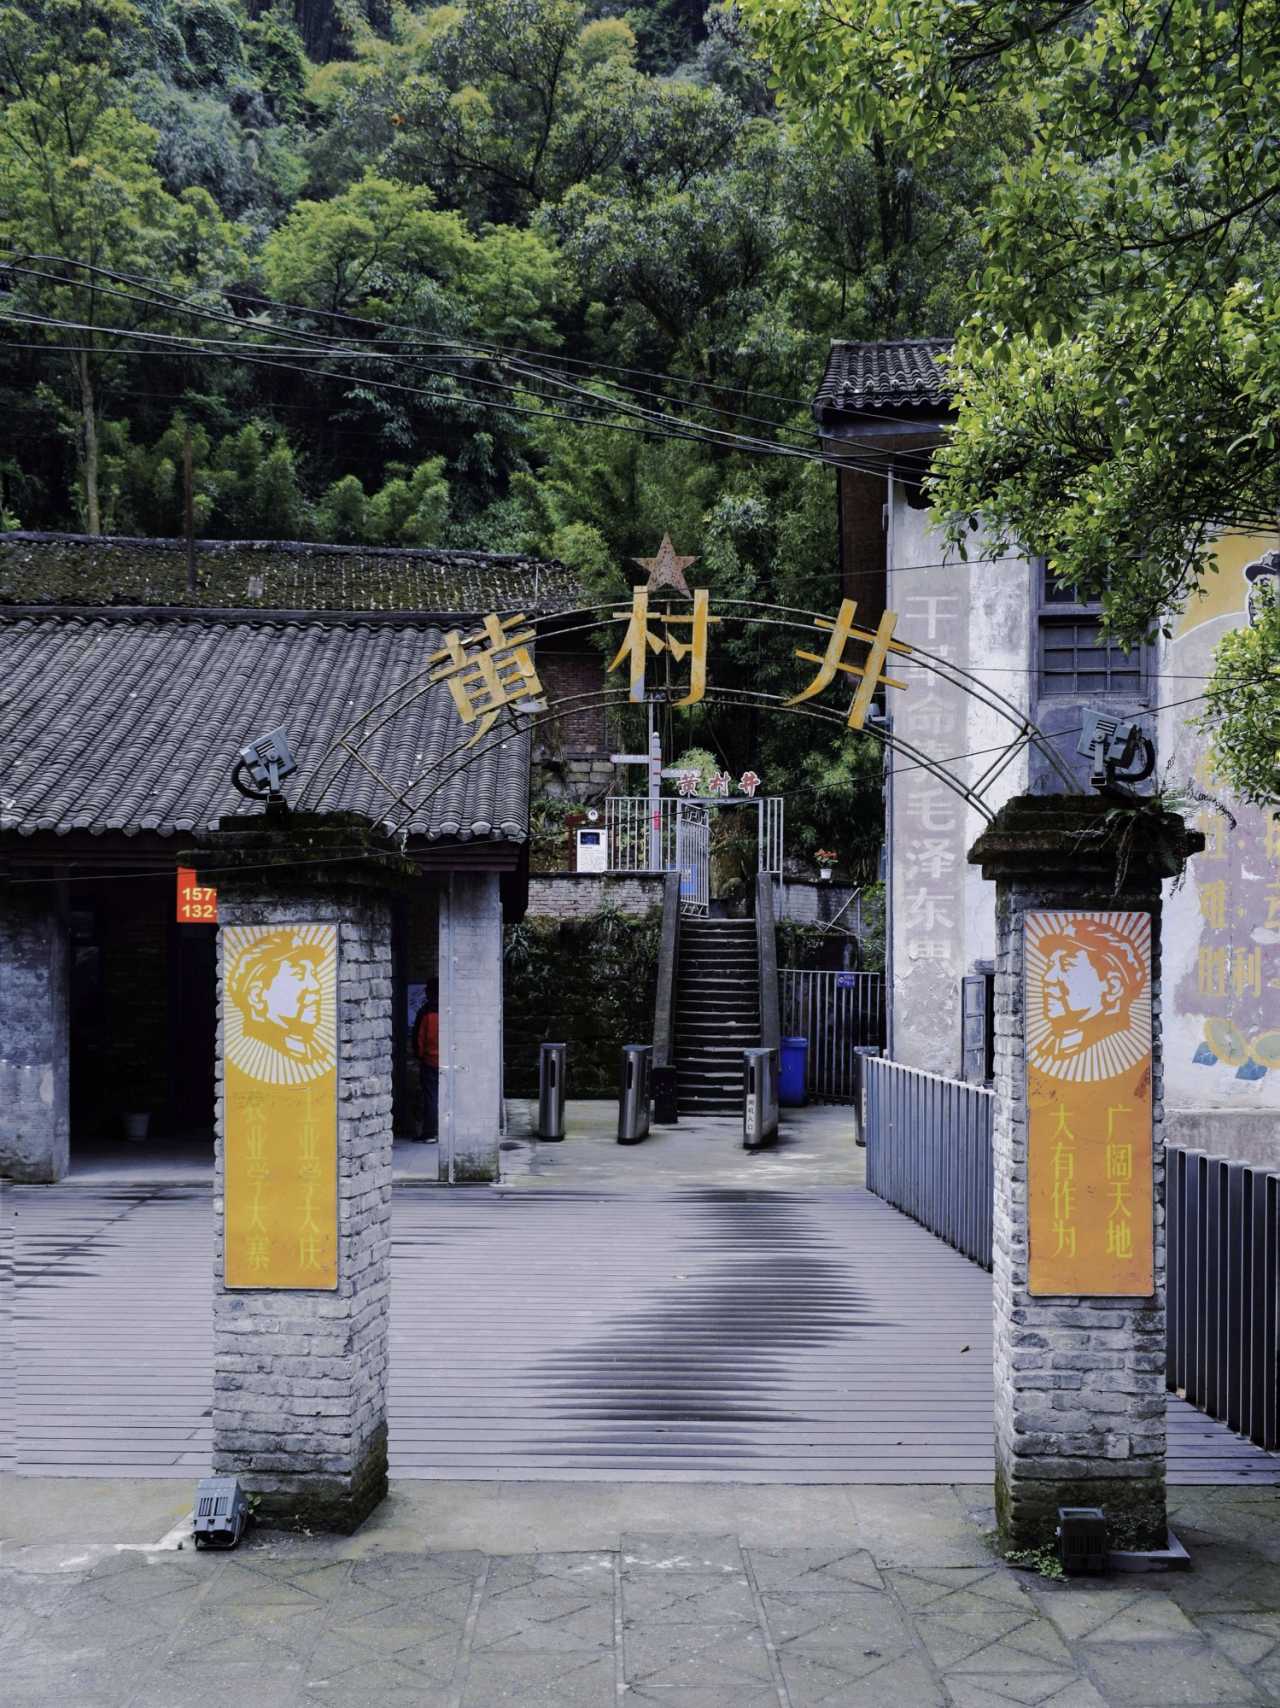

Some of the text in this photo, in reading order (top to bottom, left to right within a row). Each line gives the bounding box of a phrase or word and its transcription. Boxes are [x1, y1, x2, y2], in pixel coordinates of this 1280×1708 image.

[427, 585, 912, 749] 黄村井
[676, 771, 761, 798] 黄村井
[1048, 1102, 1077, 1259] 大有作为
[1105, 1102, 1134, 1259] 广阔天地
